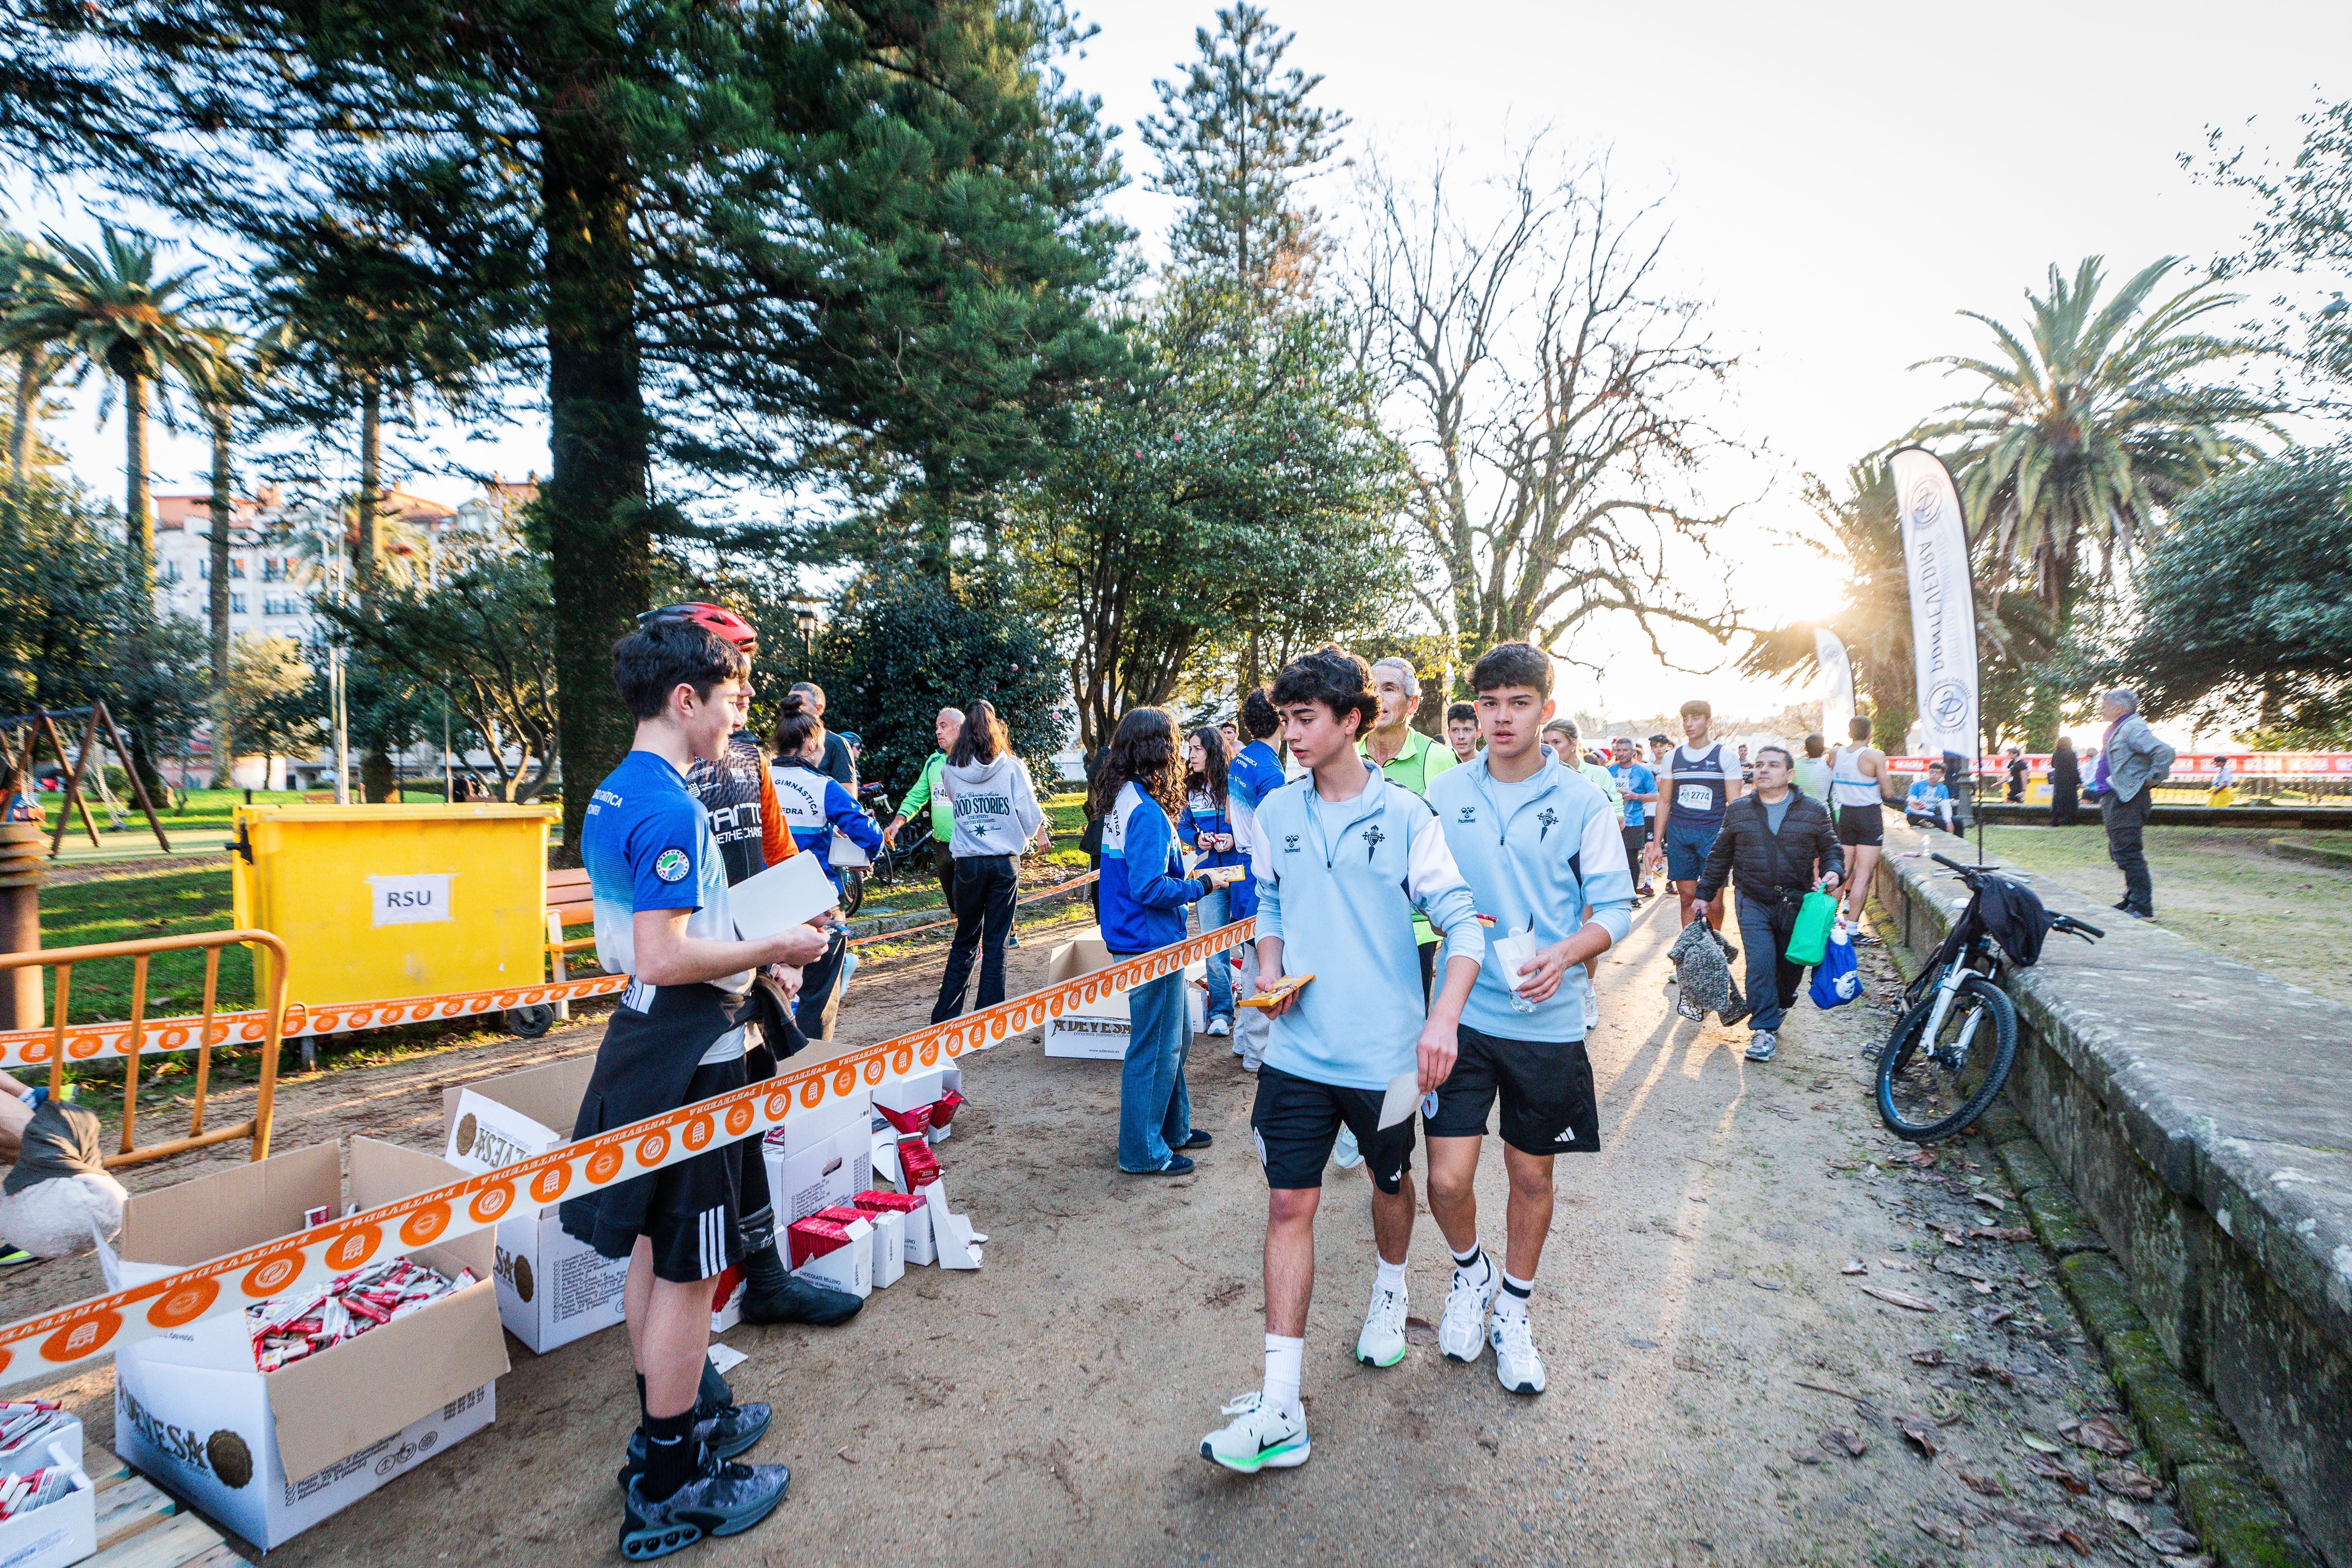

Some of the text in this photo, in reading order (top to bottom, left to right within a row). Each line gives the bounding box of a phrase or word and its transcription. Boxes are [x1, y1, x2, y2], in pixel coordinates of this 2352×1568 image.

[775, 779, 818, 816] GIMNÁSTICA
[1691, 791, 1710, 800] 2774
[973, 797, 1010, 816] STORIES
[659, 850, 686, 861] DEPORTE
[657, 866, 688, 880] PONTEVEDRA
[387, 890, 432, 907] RSU
[799, 1271, 823, 1281] CHOCOLATE
[824, 1277, 841, 1285] RELLENO
